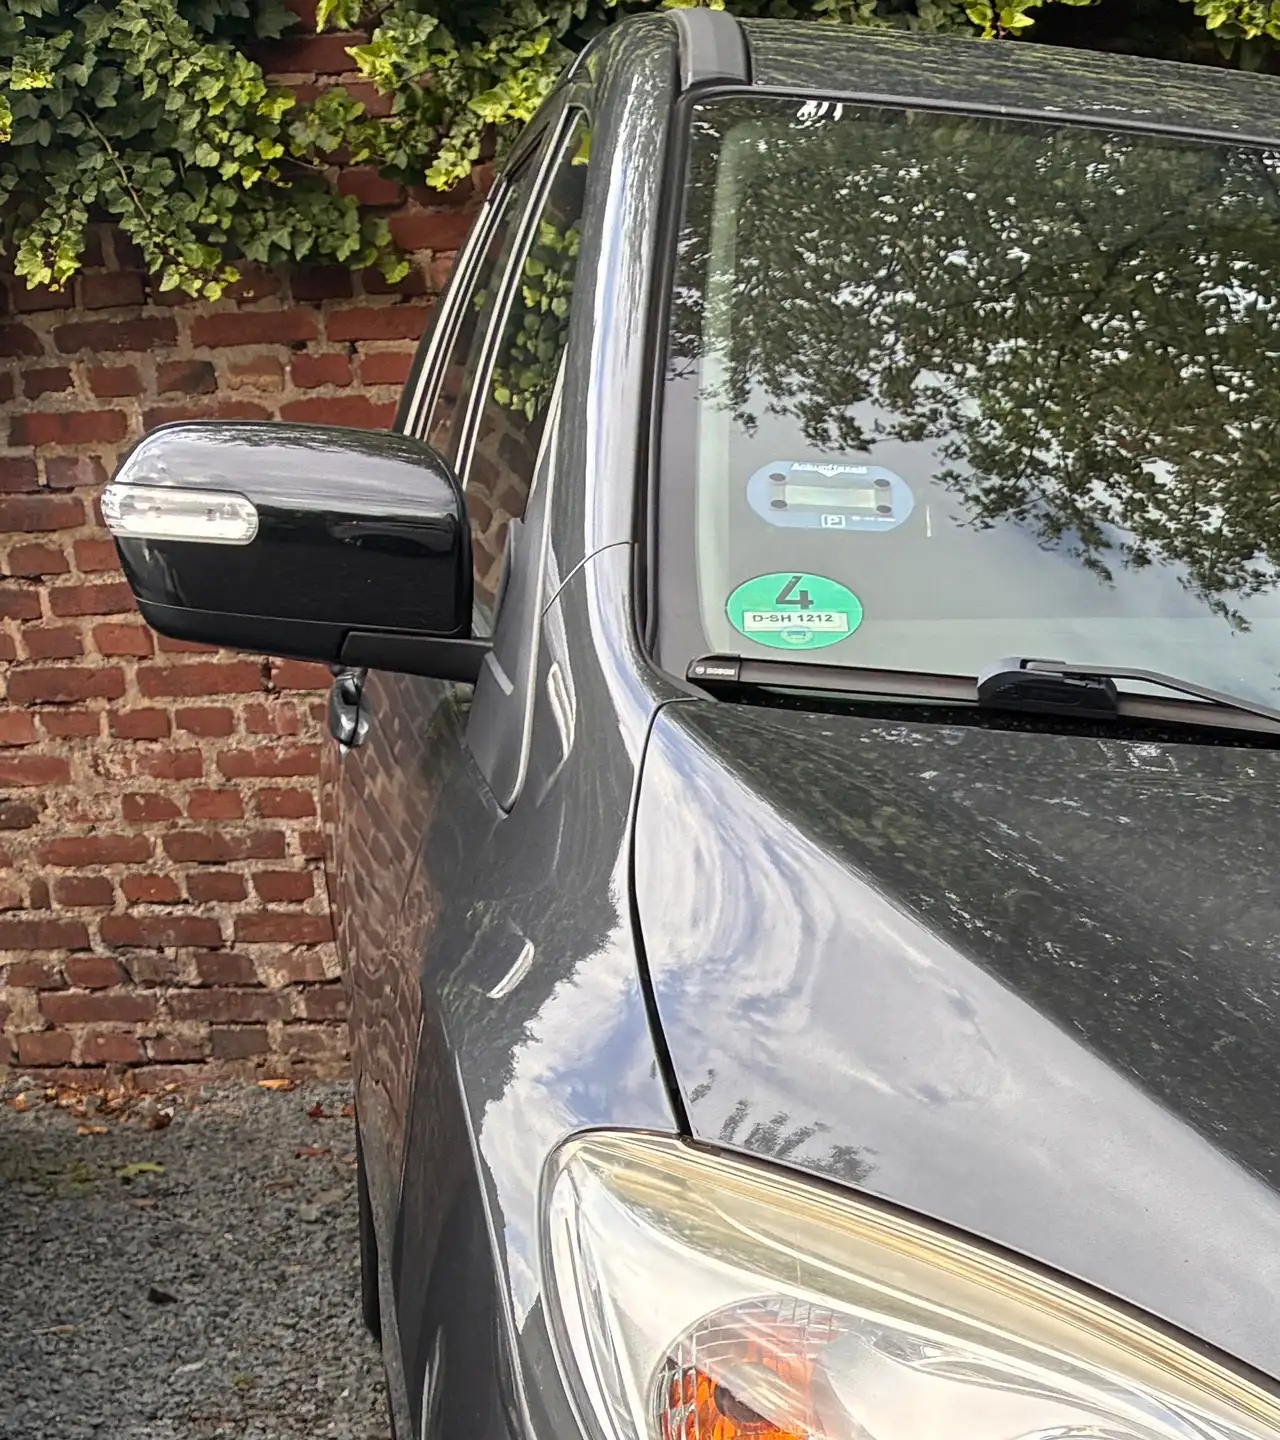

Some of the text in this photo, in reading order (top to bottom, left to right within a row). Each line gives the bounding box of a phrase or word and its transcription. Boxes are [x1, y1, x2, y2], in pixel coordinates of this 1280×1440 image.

[775, 575, 814, 610] 4
[752, 613, 834, 623] D-SH 1212
